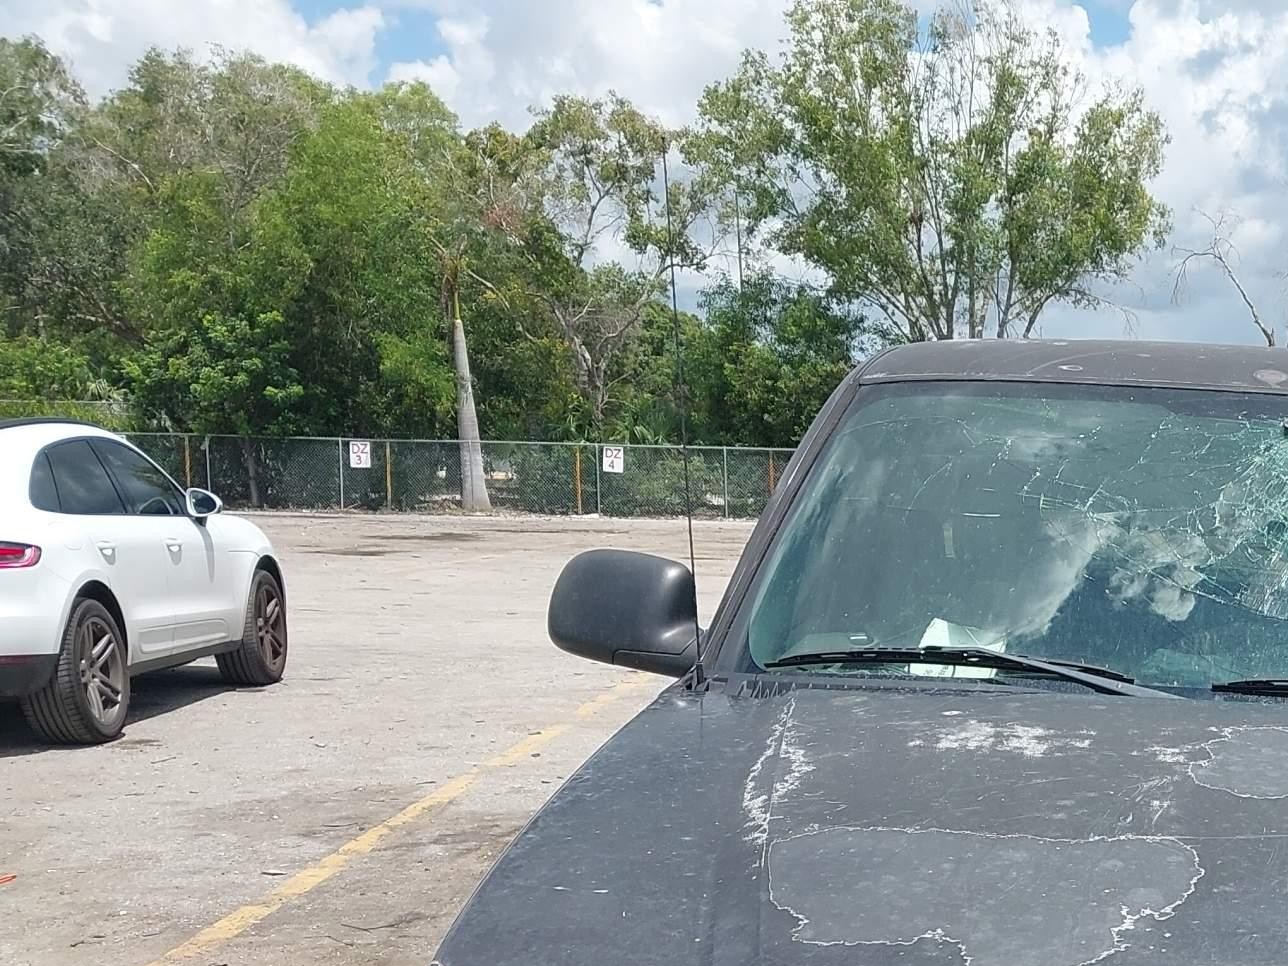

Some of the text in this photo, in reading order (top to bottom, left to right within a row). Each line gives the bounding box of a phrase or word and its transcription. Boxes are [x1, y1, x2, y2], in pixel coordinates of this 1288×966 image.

[351, 443, 369, 455] DZ
[605, 447, 622, 459] DZ
[355, 455, 362, 465] 3
[608, 459, 615, 470] 4
